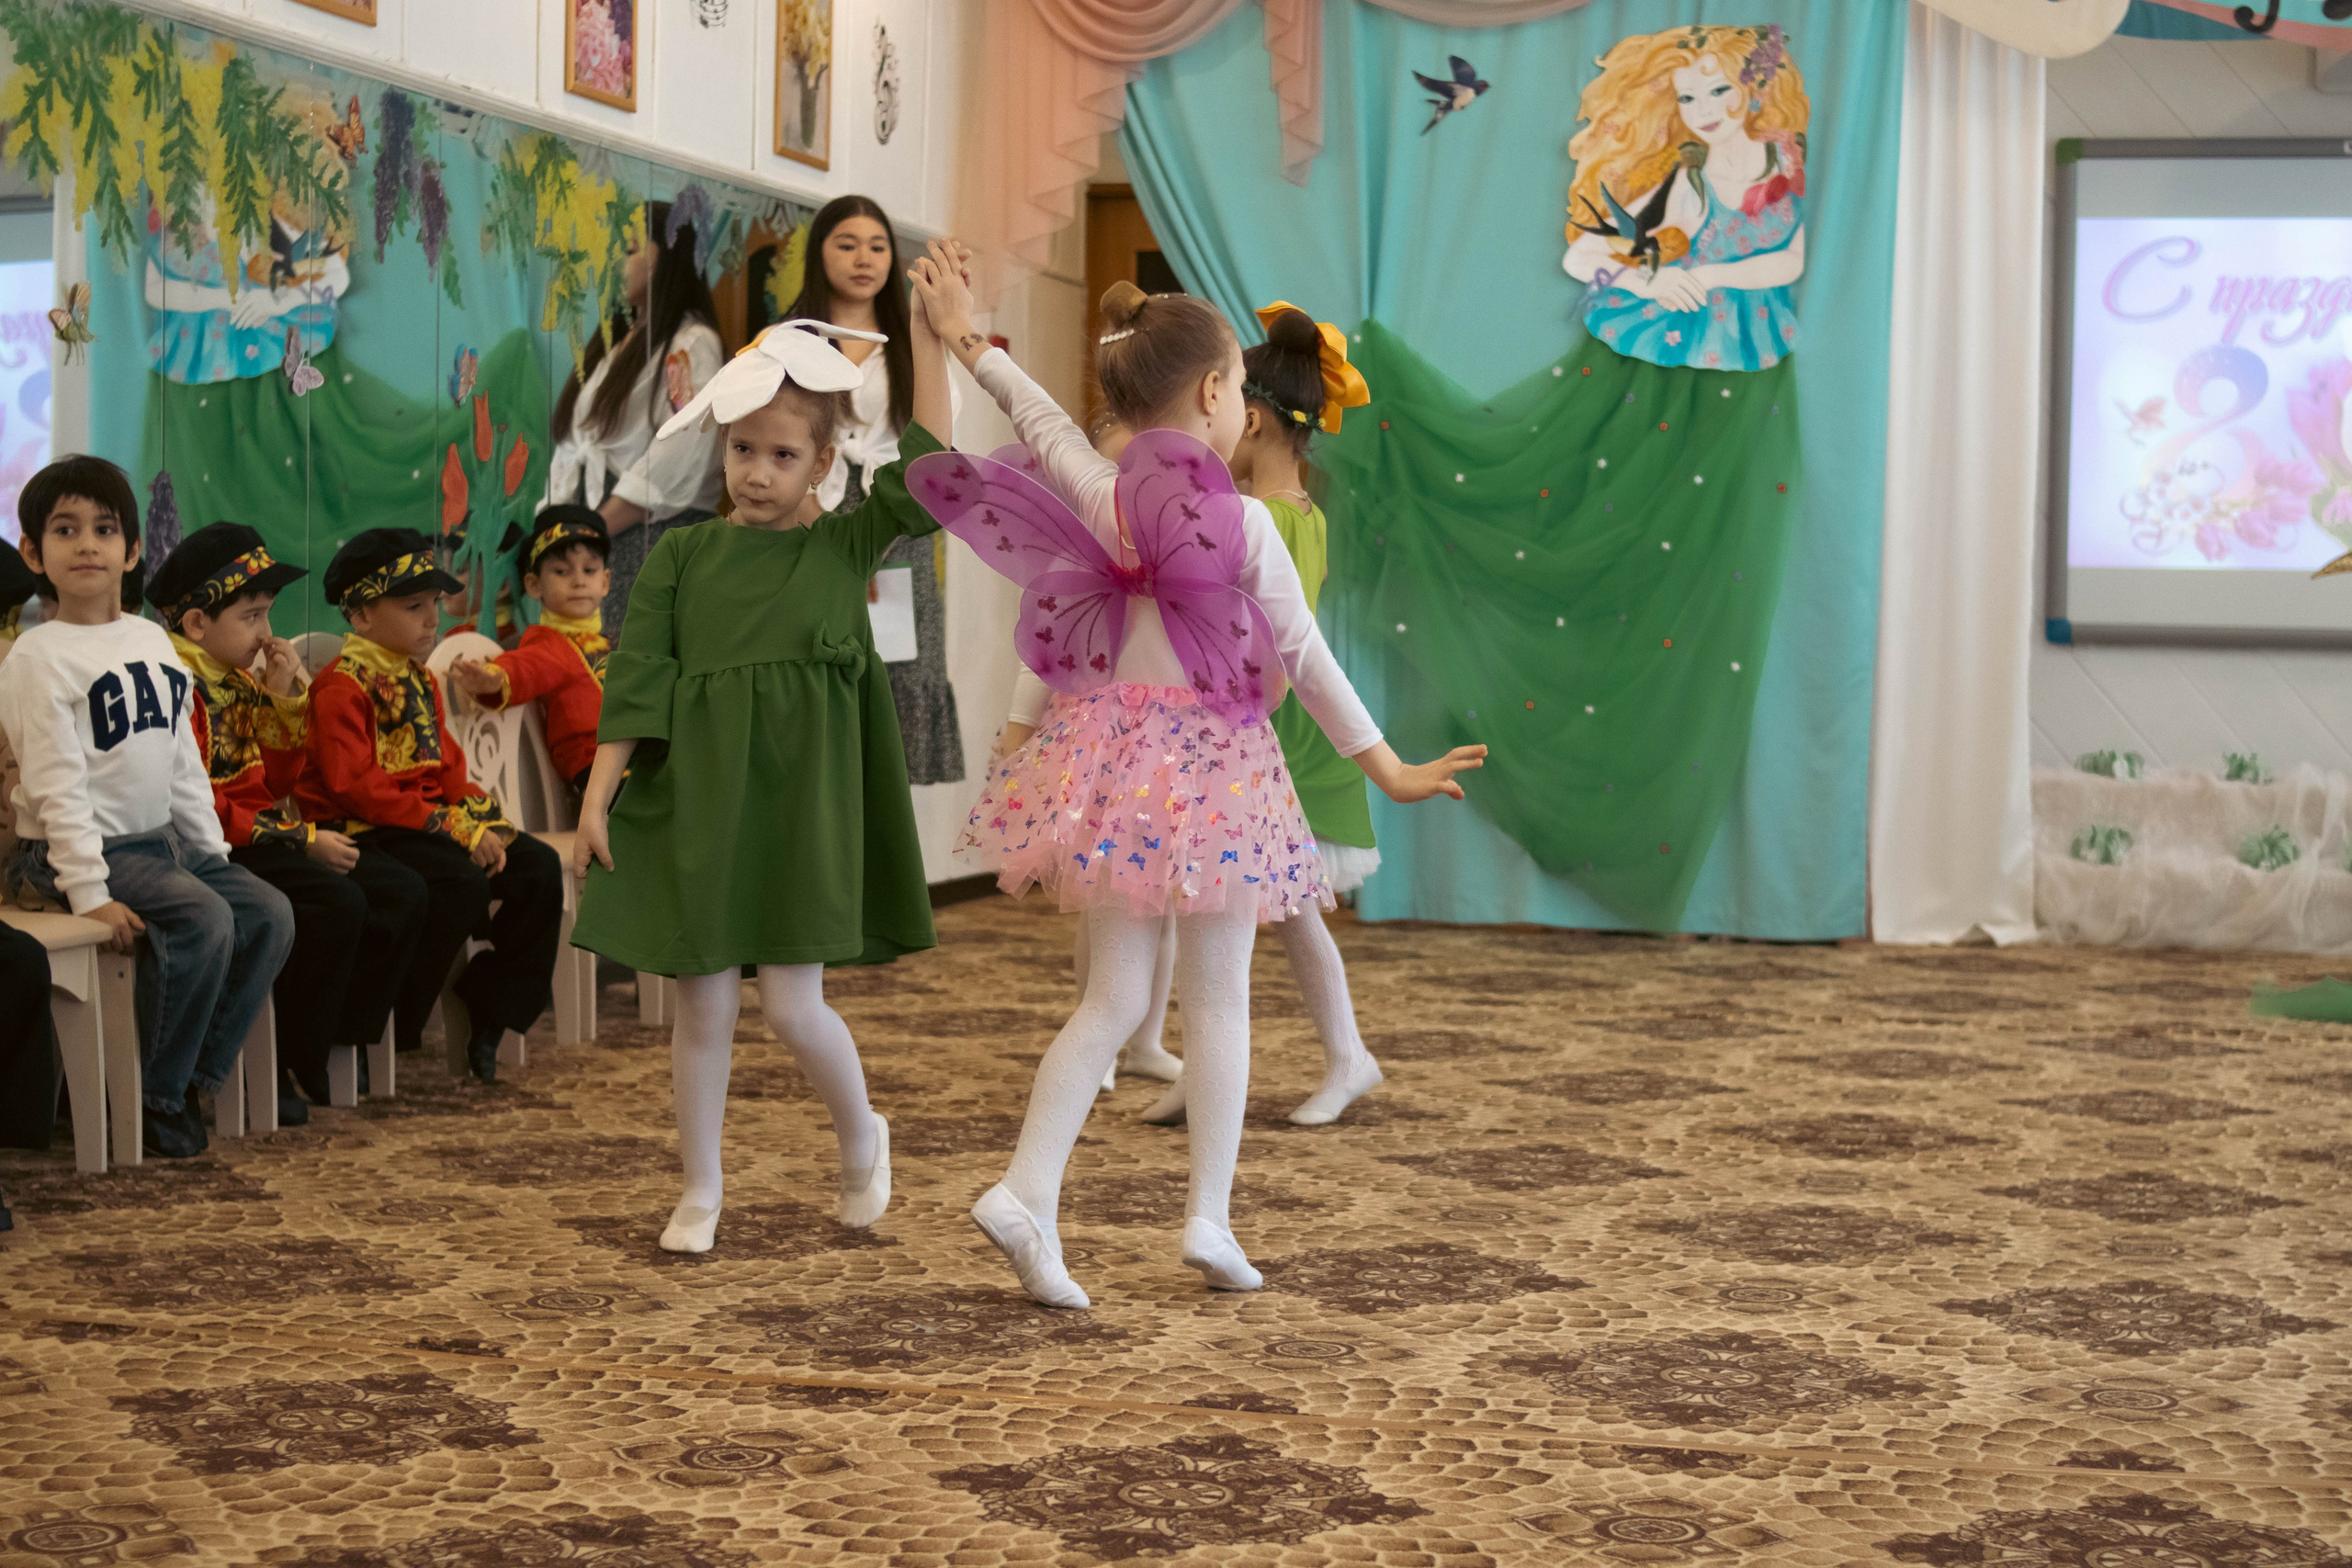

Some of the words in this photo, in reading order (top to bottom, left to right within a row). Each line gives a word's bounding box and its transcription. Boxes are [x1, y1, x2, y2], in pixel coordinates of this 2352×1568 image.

[2210, 276, 2352, 346] празд
[2141, 346, 2269, 509] 8
[88, 660, 187, 752] GAP
